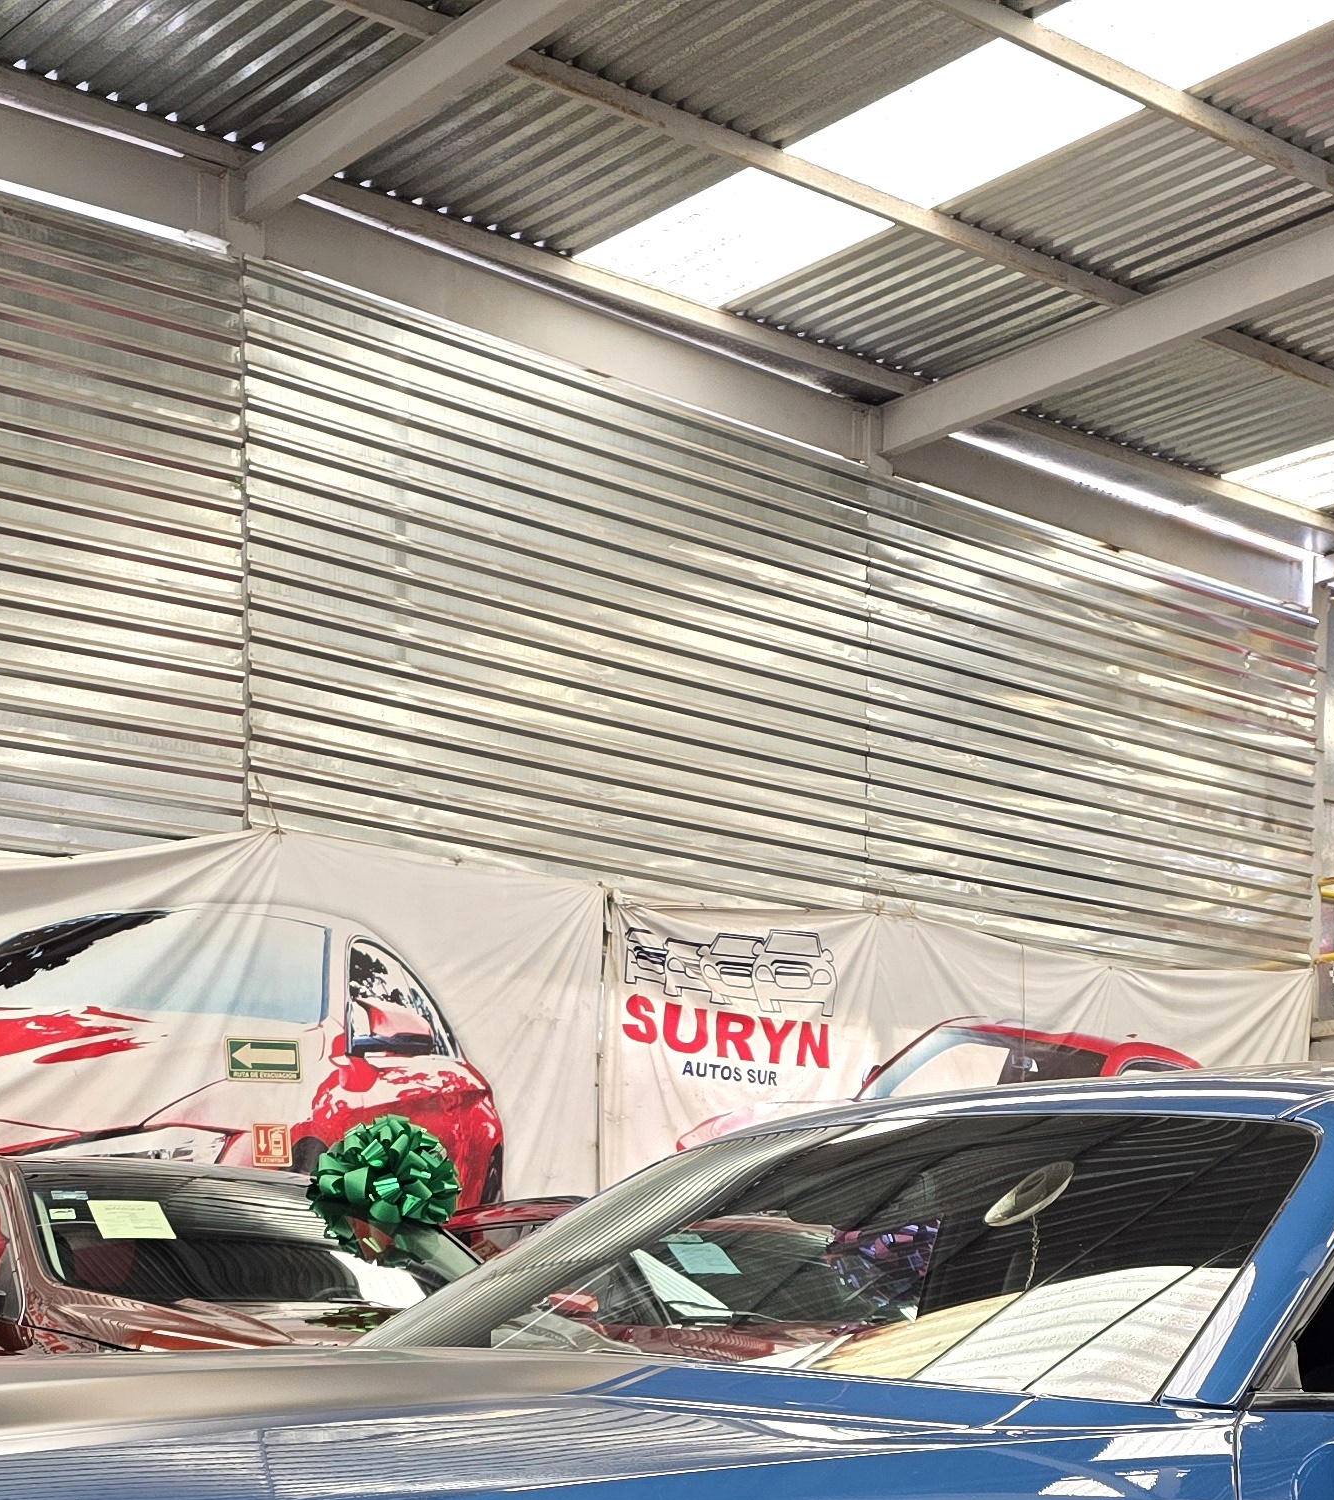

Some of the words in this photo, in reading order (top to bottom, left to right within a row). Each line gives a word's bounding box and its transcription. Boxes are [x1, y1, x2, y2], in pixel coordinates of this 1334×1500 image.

[622, 993, 831, 1070] SURYN
[681, 1060, 744, 1083] AUTOS
[746, 1069, 778, 1087] SUR
